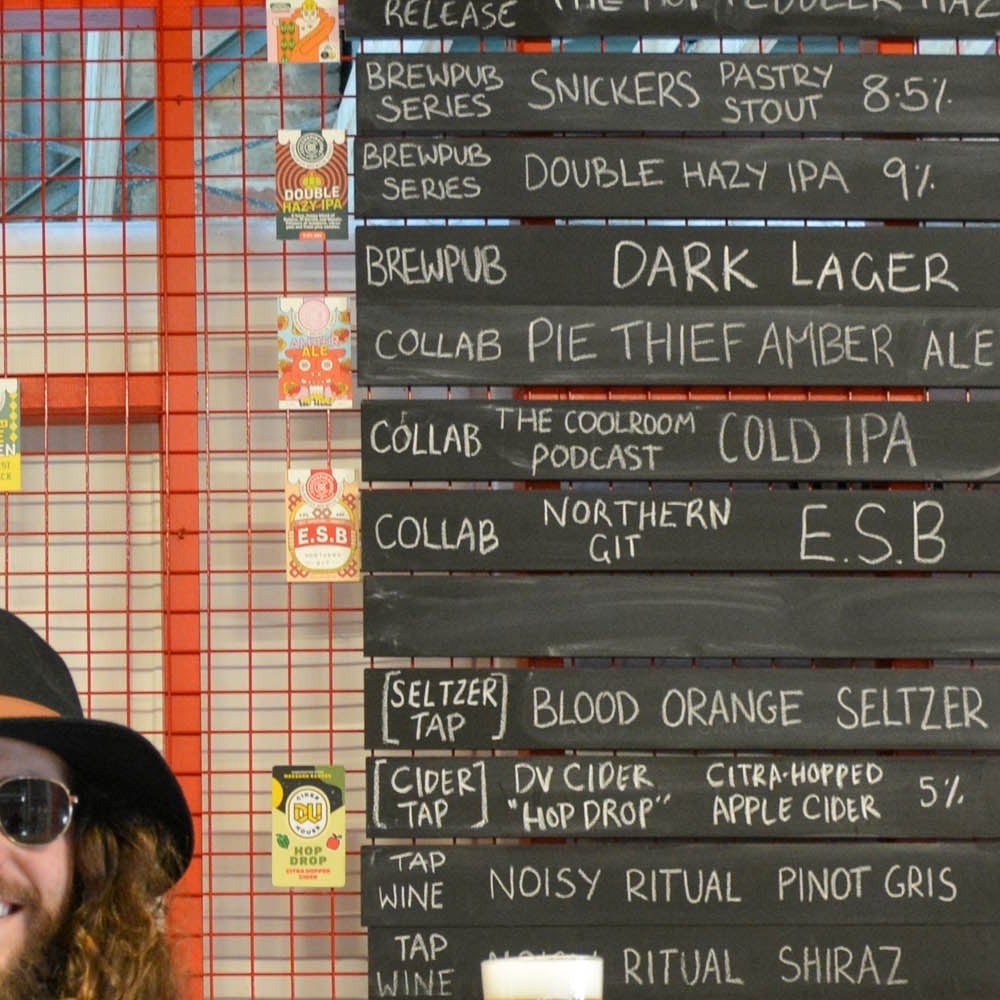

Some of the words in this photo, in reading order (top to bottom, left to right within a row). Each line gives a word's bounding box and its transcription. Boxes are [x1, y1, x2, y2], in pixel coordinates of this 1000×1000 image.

[385, 0, 518, 29] RELEASE
[366, 62, 504, 91] BREWPUB
[528, 68, 700, 110] SNICKERS
[720, 60, 833, 91] PASTRY
[376, 93, 491, 123] SERIES
[721, 94, 823, 125] STOUT
[862, 74, 953, 114] 8.5%
[362, 142, 491, 170] BREWPUB
[285, 186, 340, 200] DOUBLE
[382, 176, 481, 201] SERIES
[525, 153, 664, 191] DOUBLE
[682, 160, 767, 191] HAZY
[788, 160, 850, 194] IPA
[883, 156, 935, 201] 9%
[282, 200, 317, 213] HAZY
[322, 198, 343, 211] IPA
[366, 244, 507, 287] BREWPUB
[613, 240, 758, 291] DARK
[792, 240, 959, 293] LAGER
[375, 328, 501, 362] COLLAB
[528, 317, 597, 363] PIE
[610, 320, 747, 366] THIEF
[758, 321, 895, 369] AMBER
[923, 329, 994, 371] ALE
[496, 407, 553, 434] THE
[564, 411, 695, 435] COOLROOM
[370, 419, 482, 457] COLLAB
[719, 411, 821, 464] COLD
[845, 411, 918, 467] IPA
[531, 442, 663, 477] PODCAST
[544, 496, 732, 530] NORTHERN
[297, 525, 348, 545] E.S.B
[375, 514, 500, 555] COLLAB
[800, 500, 947, 565] E.S.B
[590, 533, 641, 565] GIT
[533, 686, 640, 729] BLOOD
[662, 686, 804, 728] ORANGE
[836, 686, 989, 731] SELTZER
[514, 762, 554, 794] DV
[563, 761, 655, 792] CIDER
[919, 775, 964, 809] 5%
[713, 794, 793, 826] APPLE
[802, 794, 881, 825] CIDER
[290, 856, 327, 865] DROP
[294, 846, 322, 856] HOP
[390, 851, 446, 873] TAP
[378, 881, 444, 911] WINE
[489, 865, 601, 901] NOISY
[626, 868, 742, 903] RITUAL
[778, 865, 872, 902] PINOT
[884, 864, 957, 902] GRIS
[394, 933, 448, 962] TAP
[623, 947, 745, 986] RITUAL
[778, 944, 909, 986] SHIRAZ
[376, 968, 455, 998] WINE
